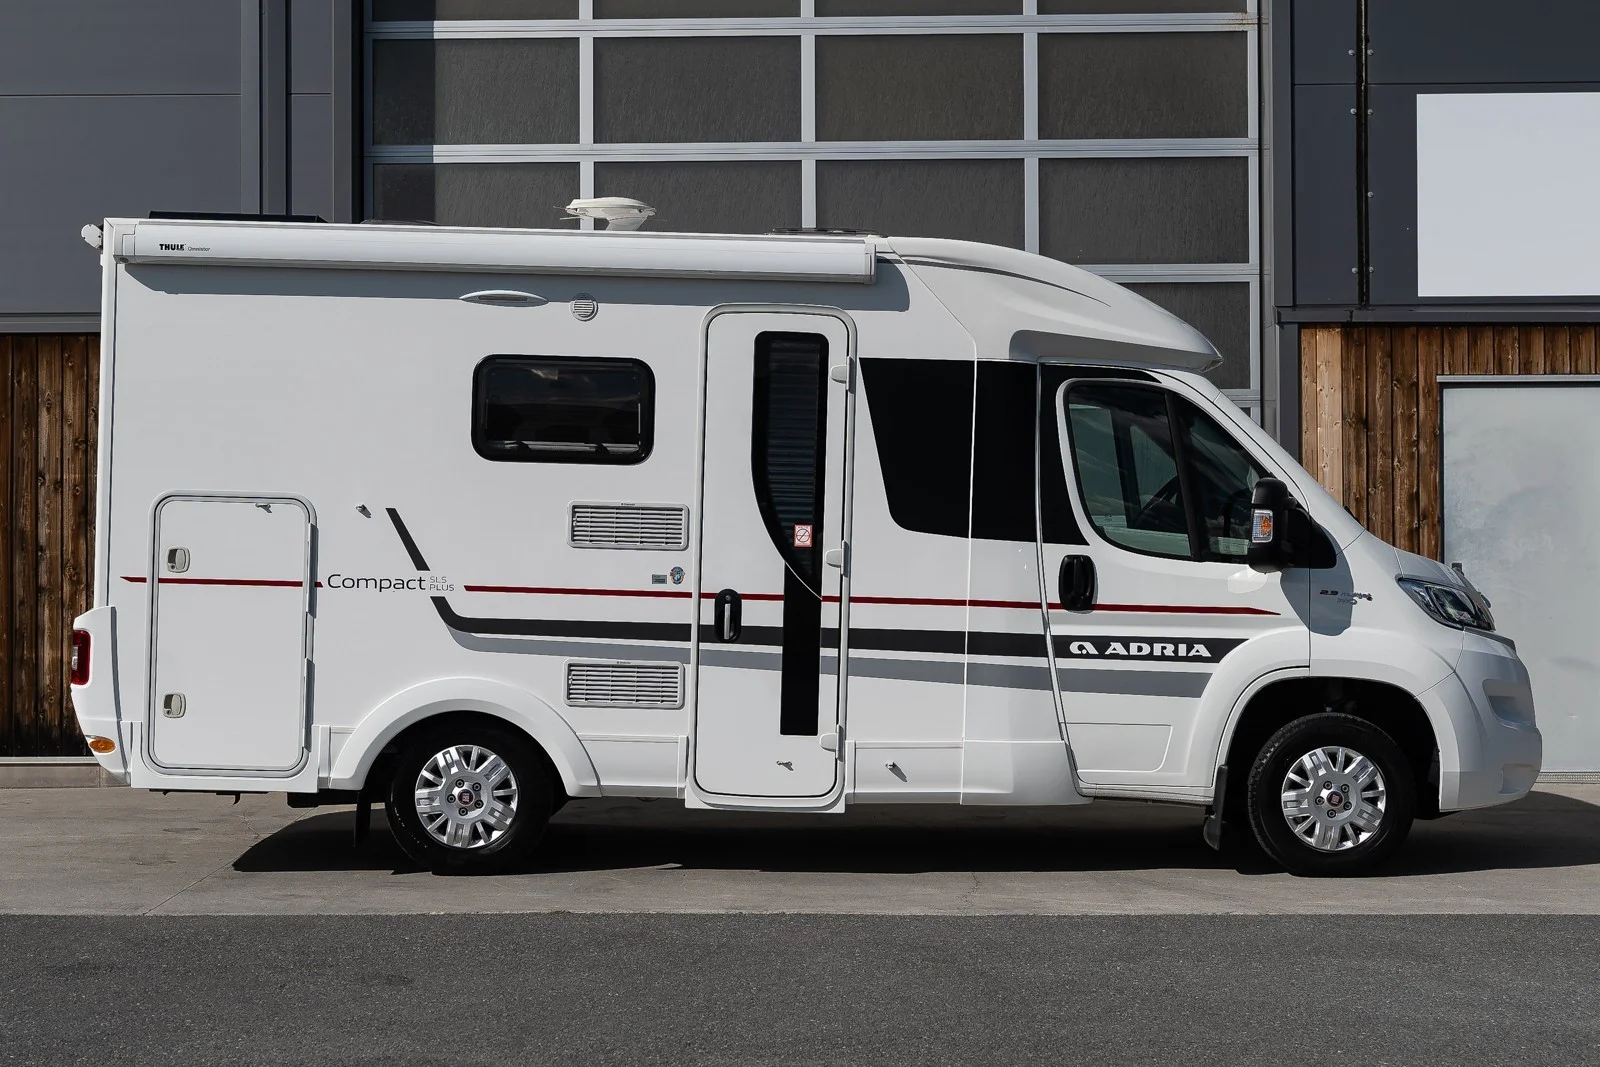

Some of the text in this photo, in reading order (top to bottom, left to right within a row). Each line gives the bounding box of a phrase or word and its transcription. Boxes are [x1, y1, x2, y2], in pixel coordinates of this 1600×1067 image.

[159, 243, 185, 251] THULE
[327, 574, 426, 592] Compact
[429, 576, 447, 584] SLS
[429, 584, 455, 592] PLUS
[1104, 642, 1212, 657] ADRIA
